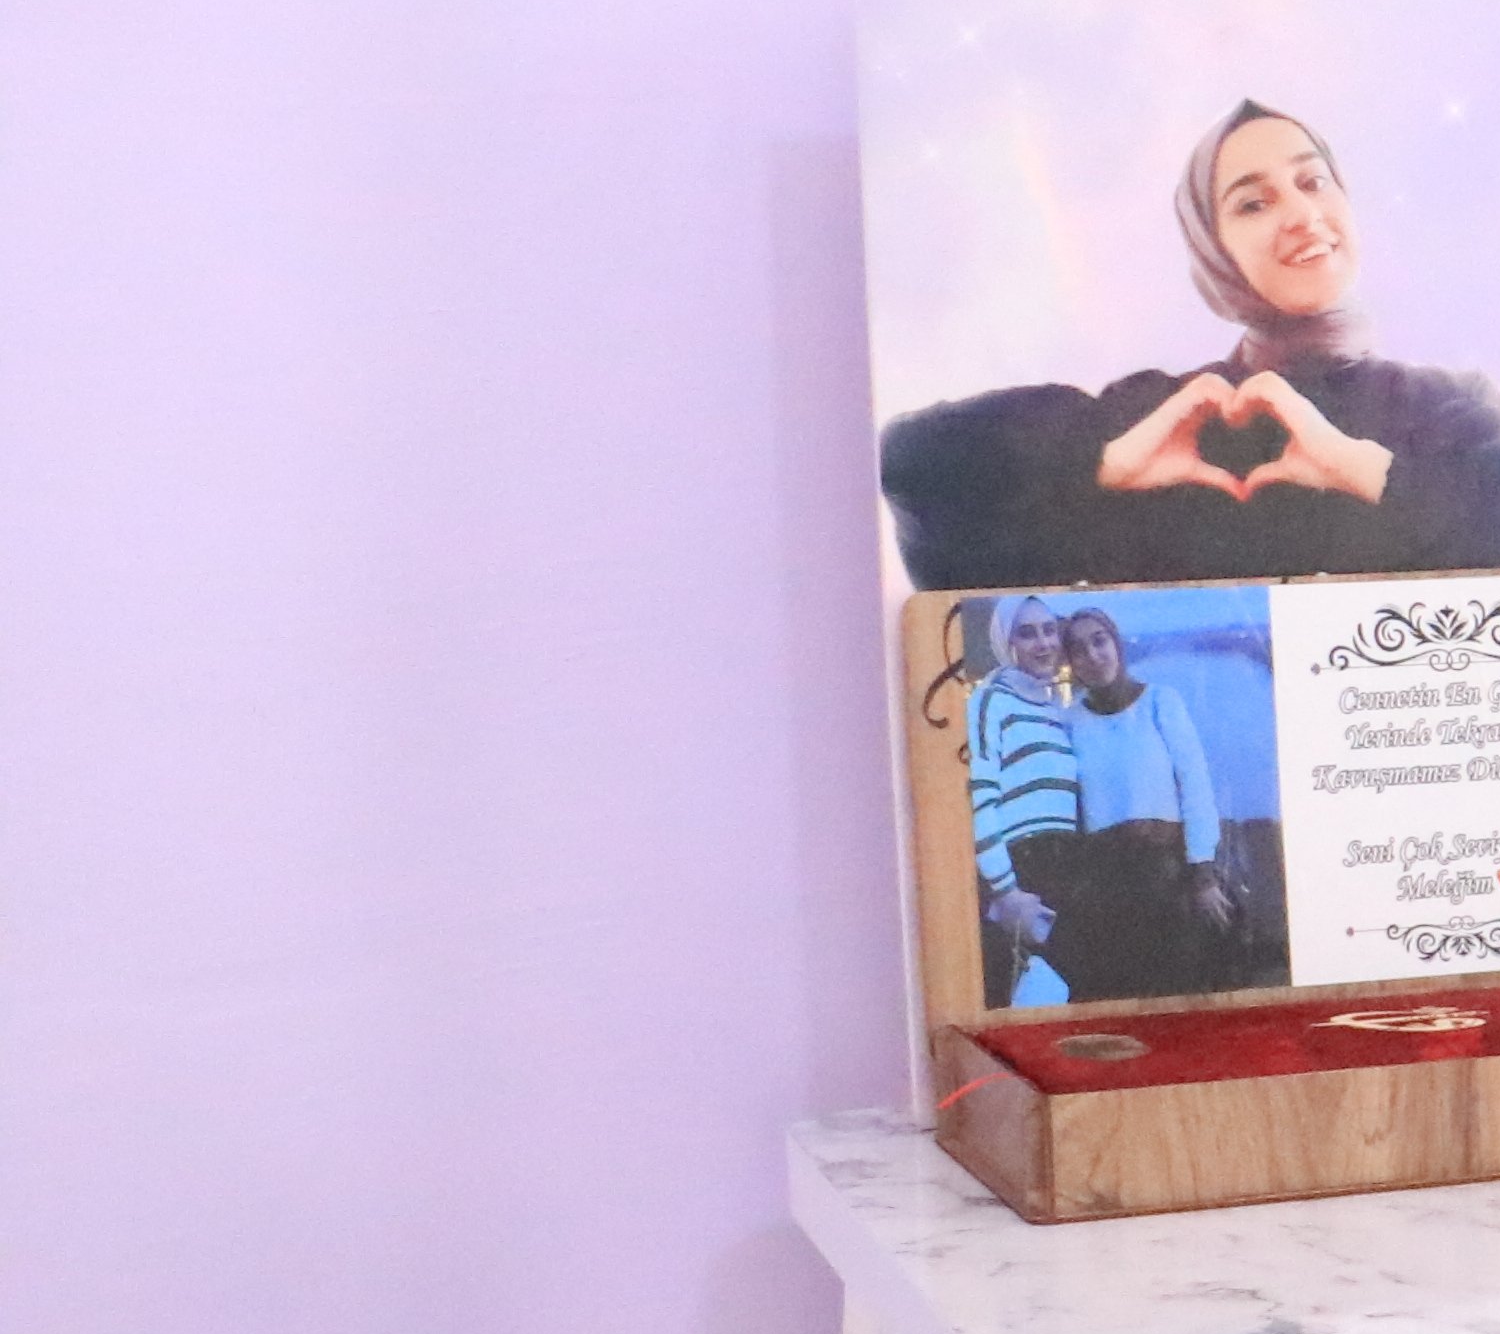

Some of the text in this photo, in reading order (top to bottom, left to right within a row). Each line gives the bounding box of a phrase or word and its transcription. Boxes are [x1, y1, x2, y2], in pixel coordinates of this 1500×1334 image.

[1339, 683, 1441, 715] Cennetin
[1445, 681, 1482, 707] En
[1345, 718, 1432, 750] Yerinde
[1313, 762, 1461, 794] Kavuşmamız
[1343, 837, 1395, 867] Seni
[1398, 832, 1451, 872] Çok
[1396, 869, 1496, 905] Meleğim
